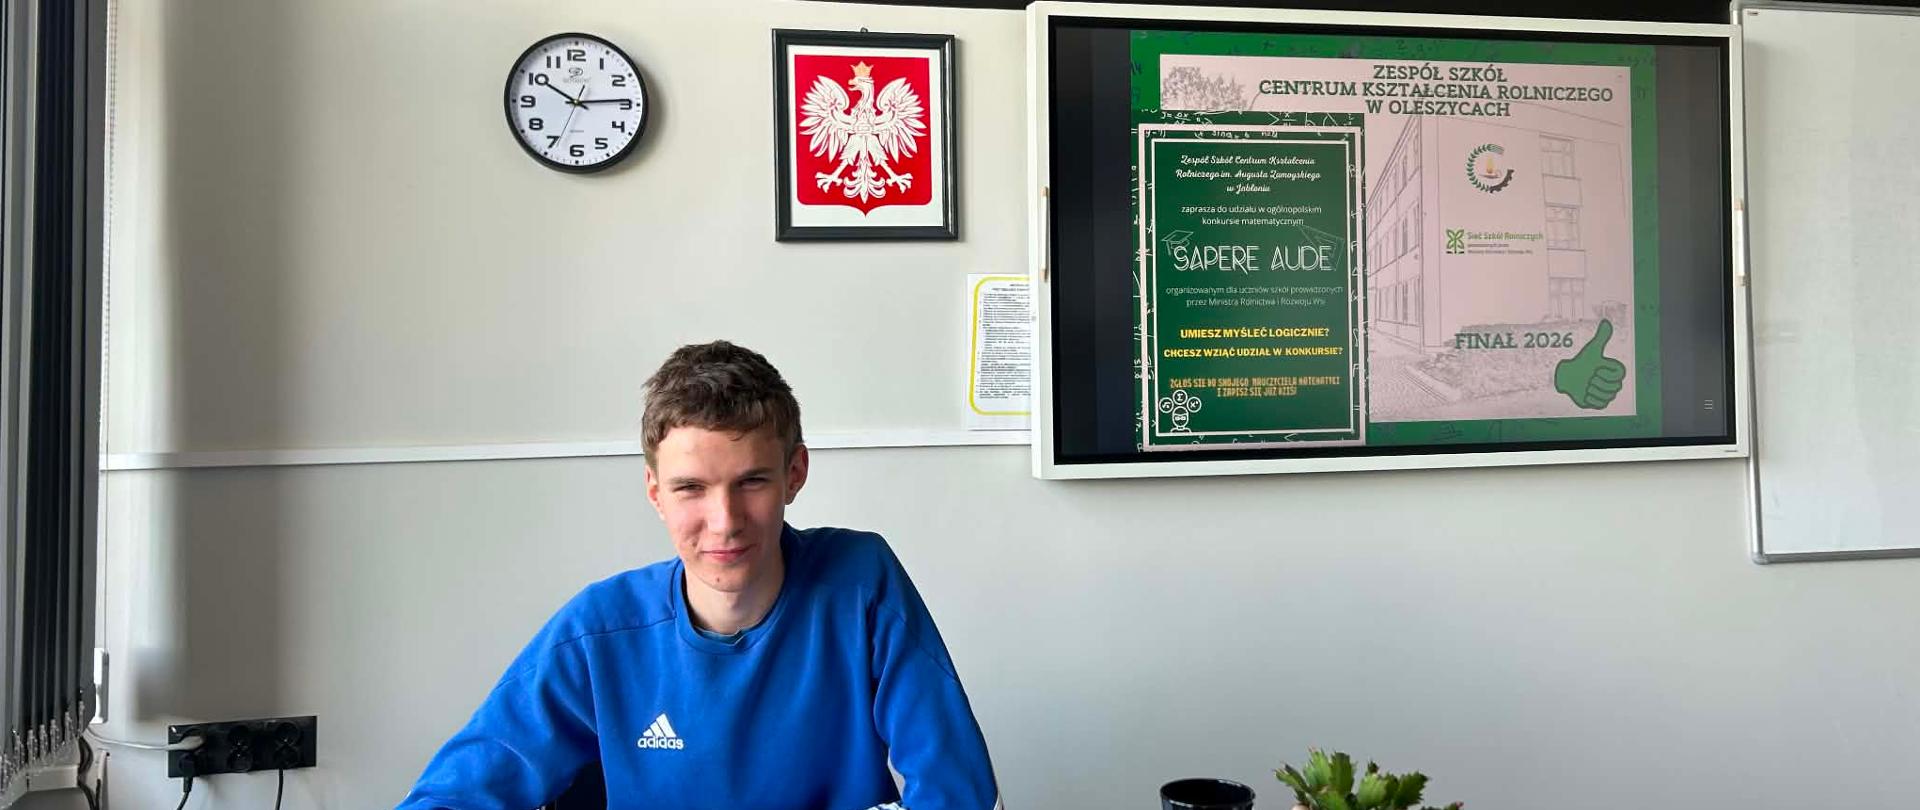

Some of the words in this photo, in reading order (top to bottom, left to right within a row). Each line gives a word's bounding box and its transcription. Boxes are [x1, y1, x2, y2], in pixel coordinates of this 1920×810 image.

[546, 56, 561, 68] 11
[566, 49, 587, 62] 12
[599, 58, 605, 70] 1
[528, 72, 549, 86] 10
[1373, 62, 1443, 81] ZESPÓŁ
[1448, 64, 1507, 83] SZKÓŁ
[611, 74, 626, 87] 2
[1258, 80, 1357, 97] CENTRUM
[1362, 82, 1493, 100] KSZTAŁCENIA
[1498, 86, 1614, 102] ROLNICZEGO
[520, 95, 536, 108] 9
[619, 99, 633, 110] 3
[1366, 100, 1384, 114] W
[1388, 101, 1511, 117] OLESZYCACH
[528, 118, 544, 131] 8
[611, 121, 626, 133] 4
[546, 135, 560, 149] 7
[594, 137, 609, 150] 5
[569, 145, 585, 157] 6
[1234, 155, 1267, 165] Centrum
[1175, 169, 1219, 180] Rolniczego
[1234, 169, 1268, 181] Augusta
[1269, 169, 1321, 182] Zamoyskiego
[1217, 205, 1228, 213] do
[1202, 217, 1240, 225] konkursie
[1241, 218, 1304, 227] matematycznym
[1173, 245, 1260, 275] SAPERE
[1270, 245, 1333, 271] AUDE
[1180, 328, 1222, 339] UMIESZ
[1222, 326, 1268, 338] MYŚLEĆ
[1269, 327, 1330, 338] LOGICZNIE?
[1454, 333, 1518, 350] FINAŁ
[1523, 332, 1574, 349] 2026
[1163, 348, 1202, 358] CHCESZ
[1203, 347, 1236, 359] WZIĄĆ
[1236, 347, 1272, 357] UDZIAŁ
[1272, 347, 1282, 356] W
[1285, 347, 1344, 356] KONKURSIE?
[637, 736, 684, 750] adidas
